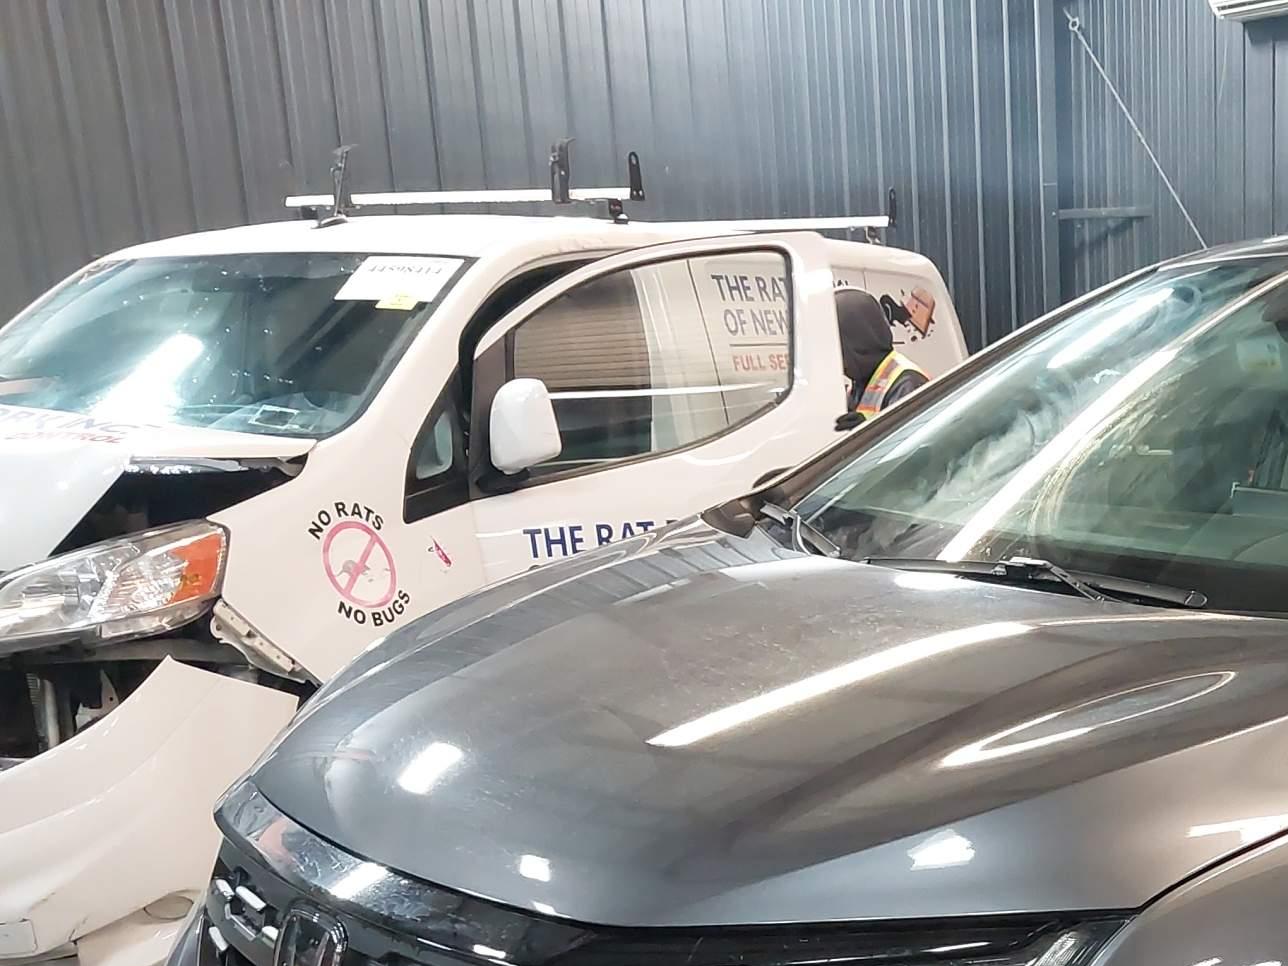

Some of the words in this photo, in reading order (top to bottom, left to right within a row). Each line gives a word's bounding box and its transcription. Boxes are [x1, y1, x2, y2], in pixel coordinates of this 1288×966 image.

[711, 274, 753, 302] THE
[723, 309, 747, 336] OF
[732, 355, 765, 372] FULL
[307, 509, 332, 540] NO
[334, 501, 384, 531] RATS
[523, 525, 586, 559] THE
[338, 601, 367, 625] NO
[371, 590, 411, 627] BUGS
